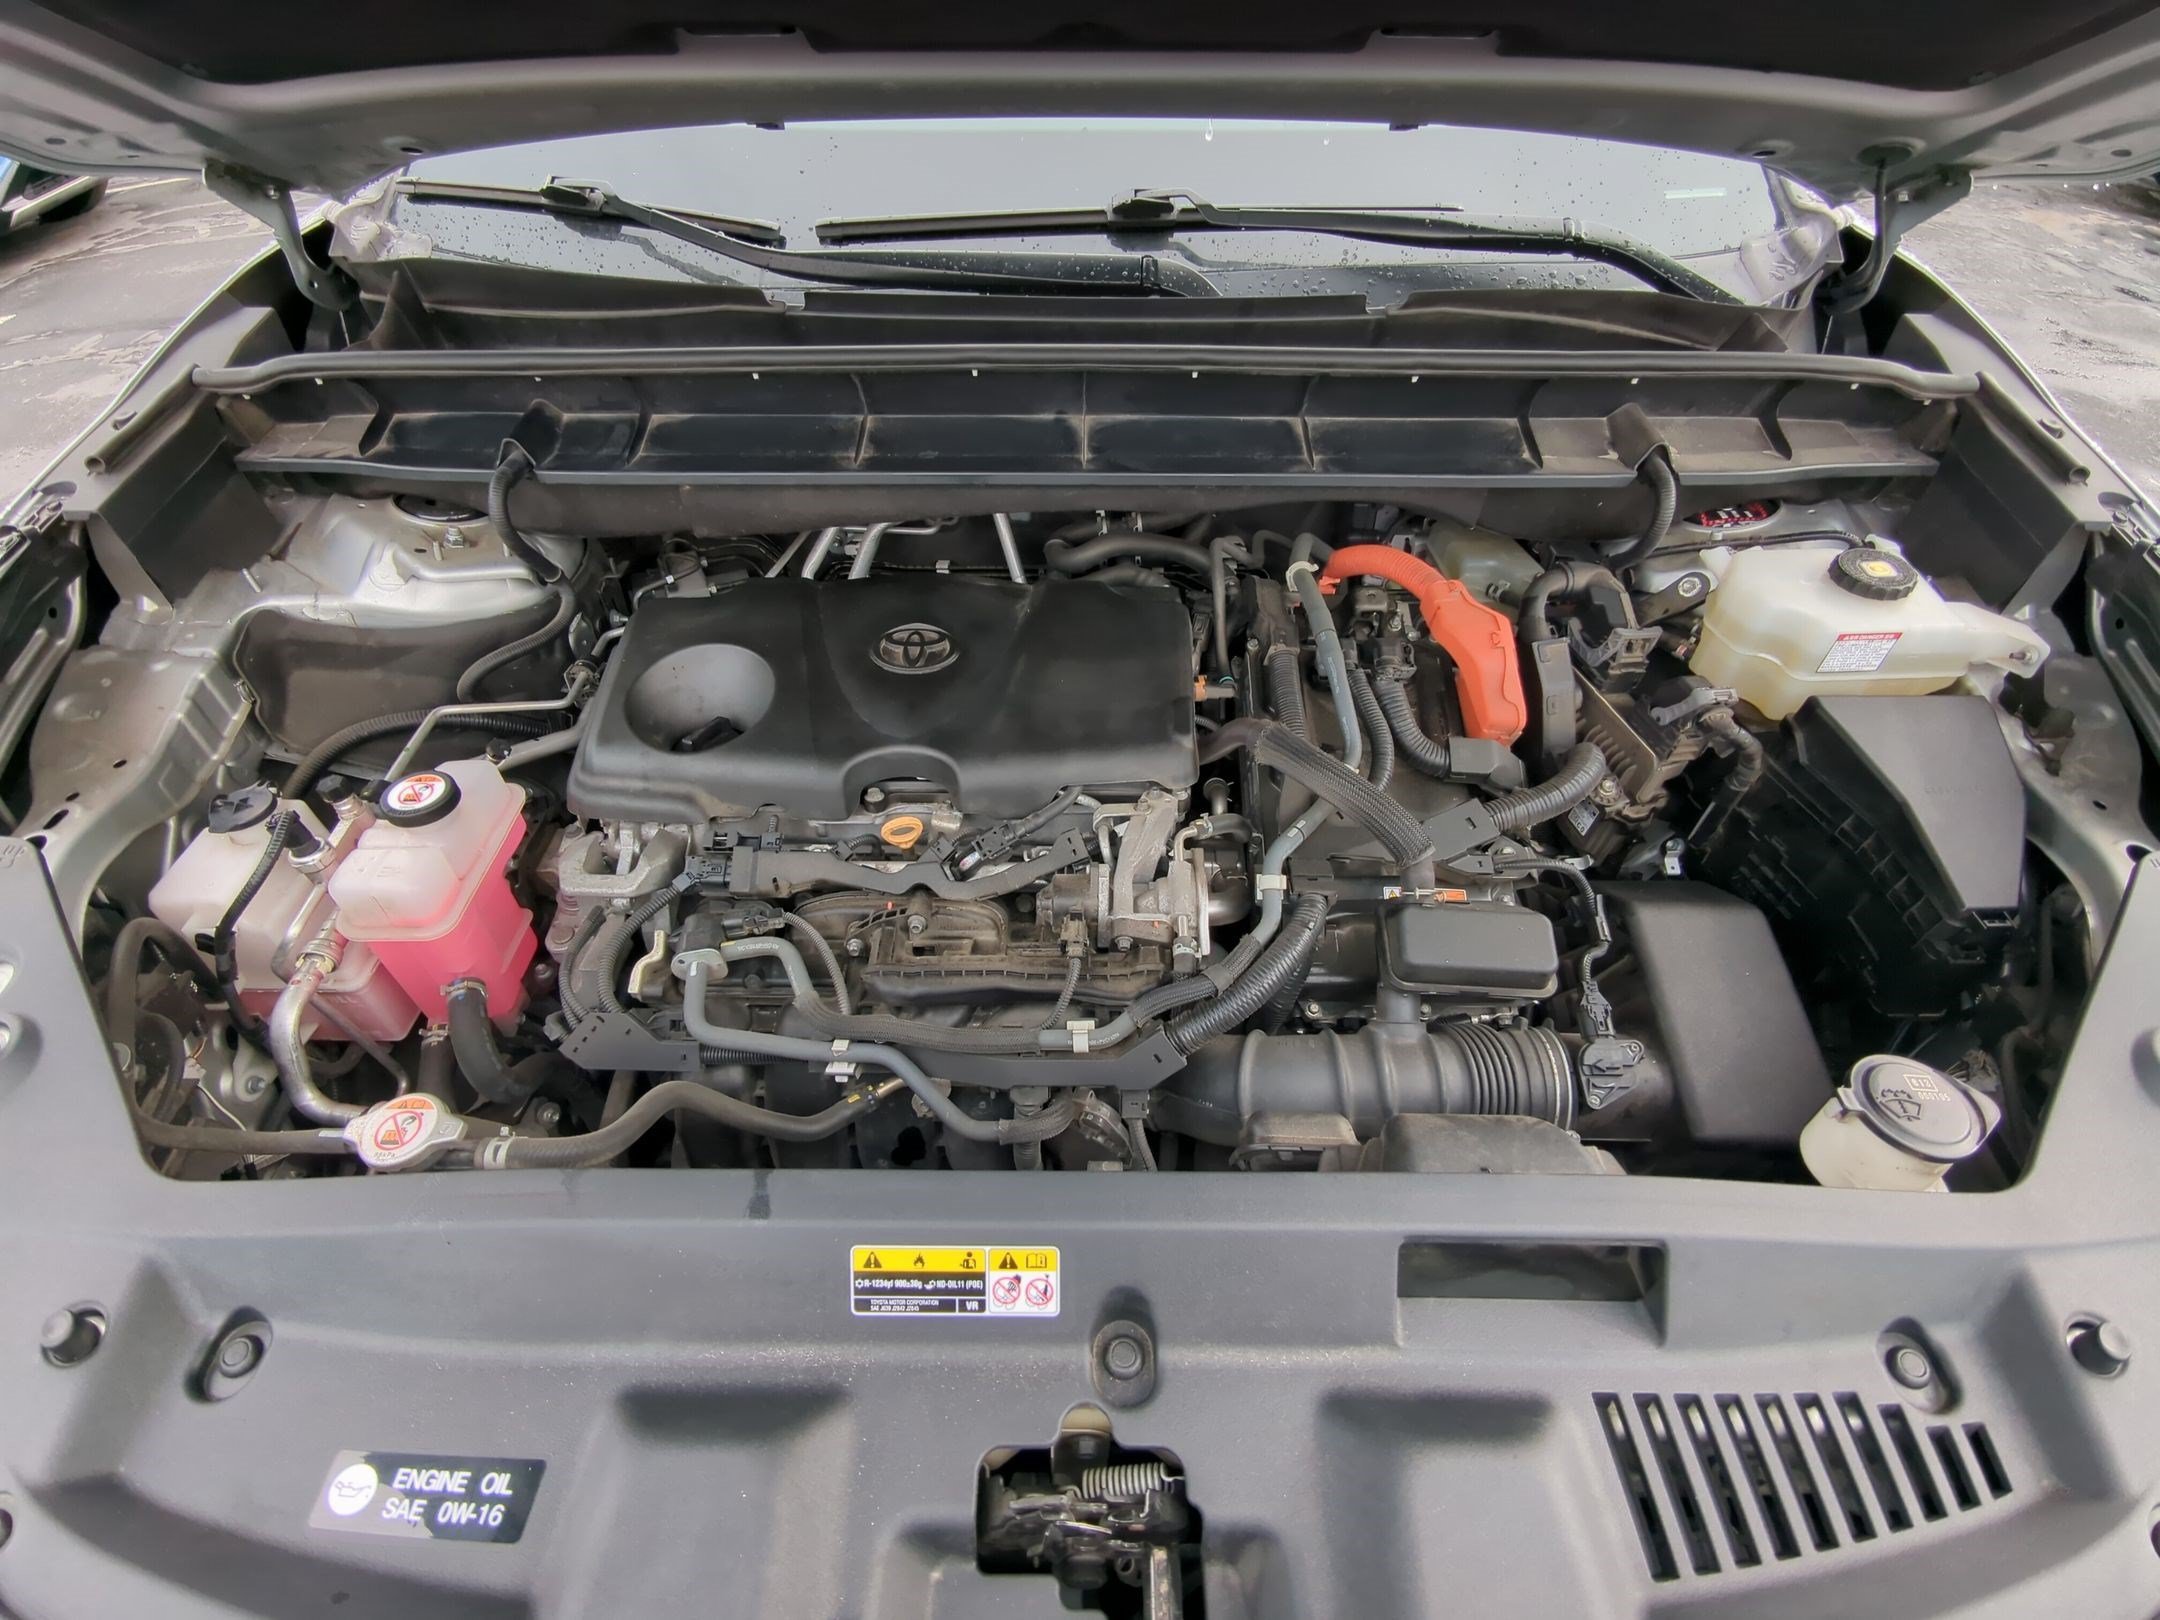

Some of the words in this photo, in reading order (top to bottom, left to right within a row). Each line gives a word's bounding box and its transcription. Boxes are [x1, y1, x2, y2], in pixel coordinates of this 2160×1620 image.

[864, 1279, 893, 1289] R-1234yf
[966, 1280, 983, 1290] (POE)
[965, 1301, 979, 1311] VR
[392, 1467, 471, 1492] ENGINE
[481, 1472, 513, 1495] OIL
[381, 1497, 427, 1521] SAE
[437, 1501, 505, 1527] 0W-16
